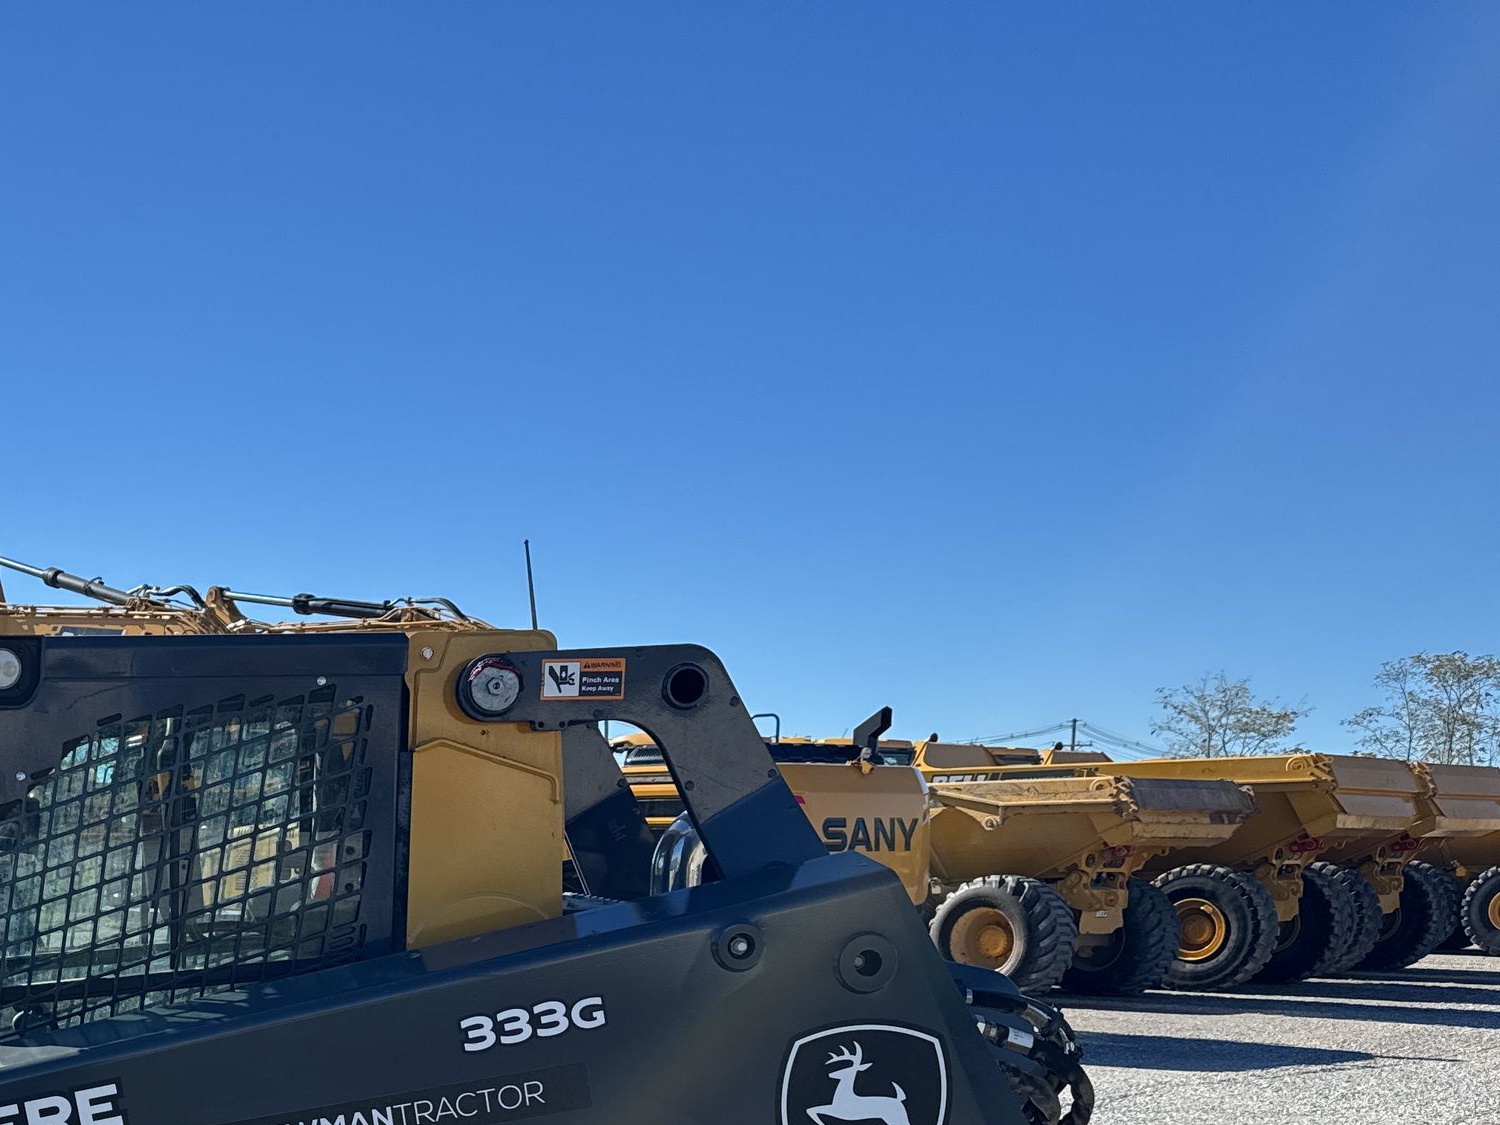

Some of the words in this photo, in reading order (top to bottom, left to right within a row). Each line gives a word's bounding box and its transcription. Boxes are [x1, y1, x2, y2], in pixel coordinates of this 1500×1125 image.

[582, 676, 602, 684] Pinch
[603, 676, 620, 684] Area
[822, 816, 919, 852] SANY
[459, 996, 606, 1052] 333G
